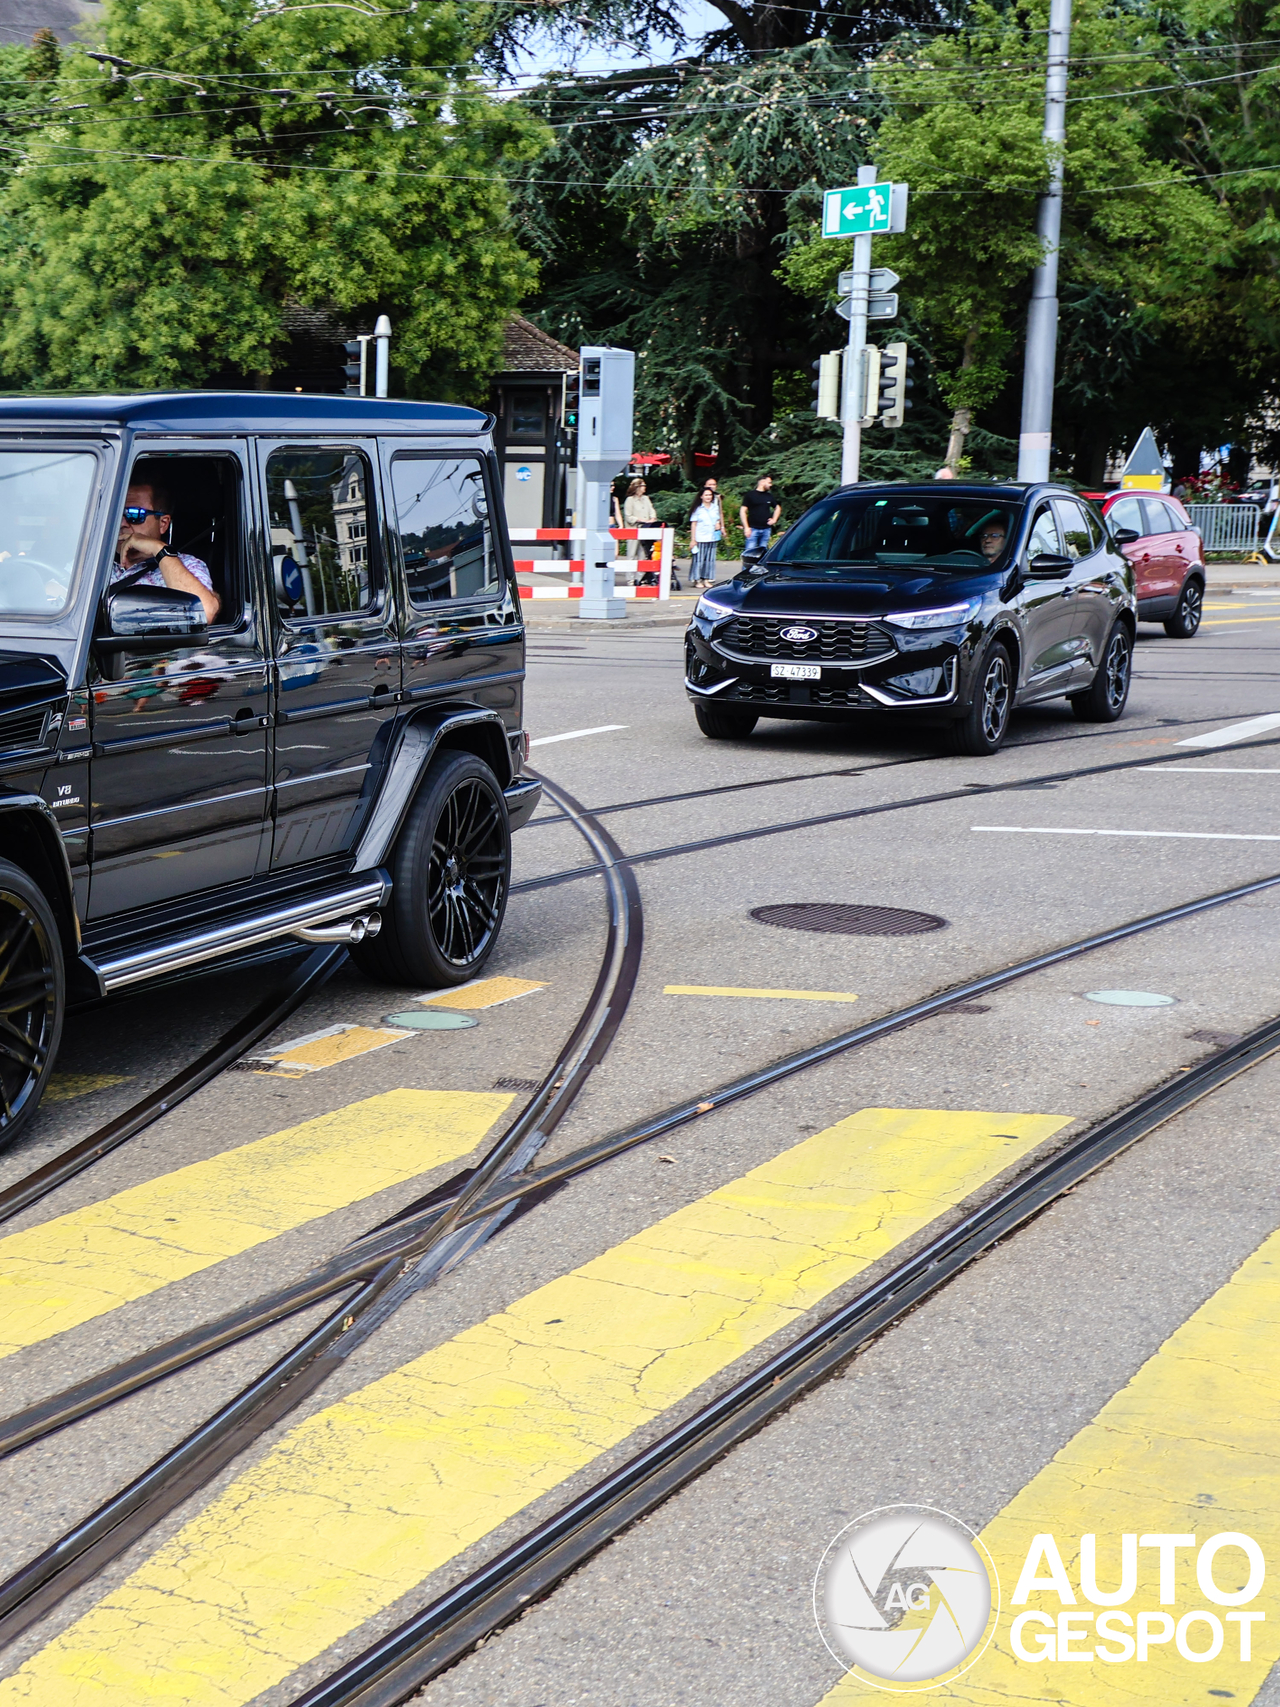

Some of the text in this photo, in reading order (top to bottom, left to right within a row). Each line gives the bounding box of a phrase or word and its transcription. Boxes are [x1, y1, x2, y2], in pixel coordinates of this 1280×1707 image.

[515, 471, 532, 480] WC
[787, 629, 810, 639] Ford
[57, 785, 72, 796] V8
